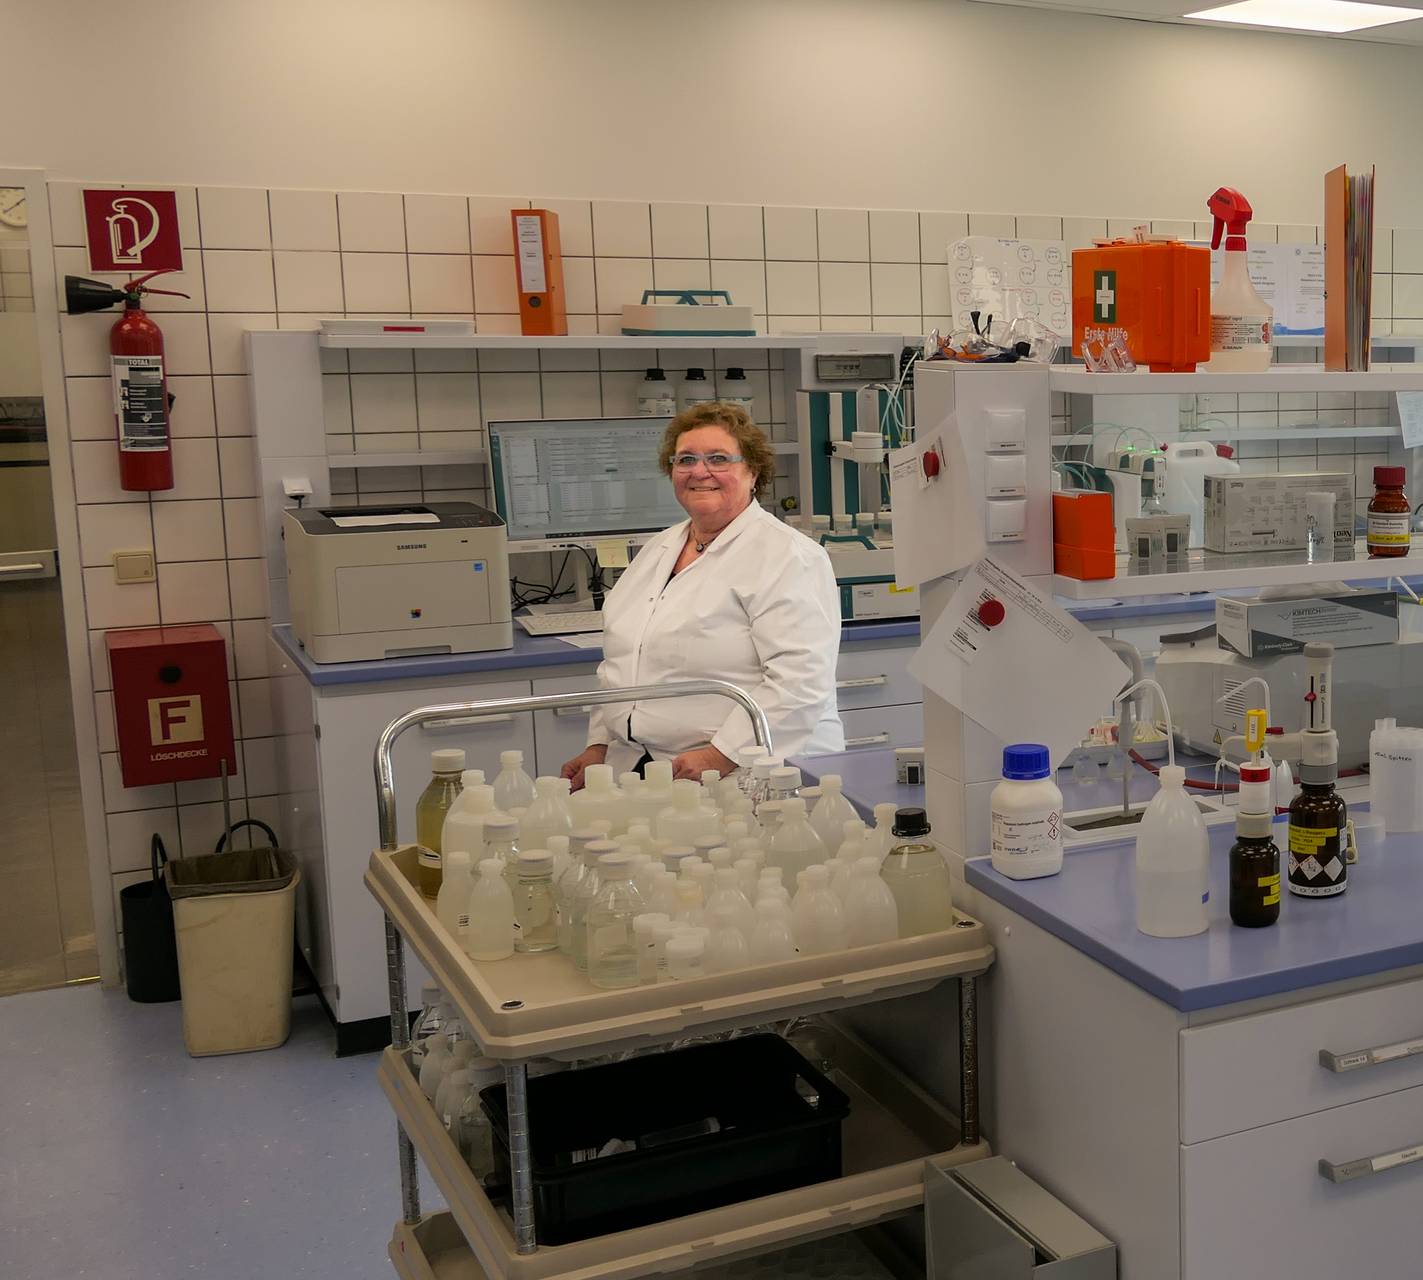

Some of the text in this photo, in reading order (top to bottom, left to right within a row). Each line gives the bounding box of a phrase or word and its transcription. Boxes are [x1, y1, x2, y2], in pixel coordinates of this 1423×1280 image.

[396, 543, 427, 551] SAMSUNG
[159, 700, 191, 741] F
[150, 748, 208, 762] LÖSCHDECKE
